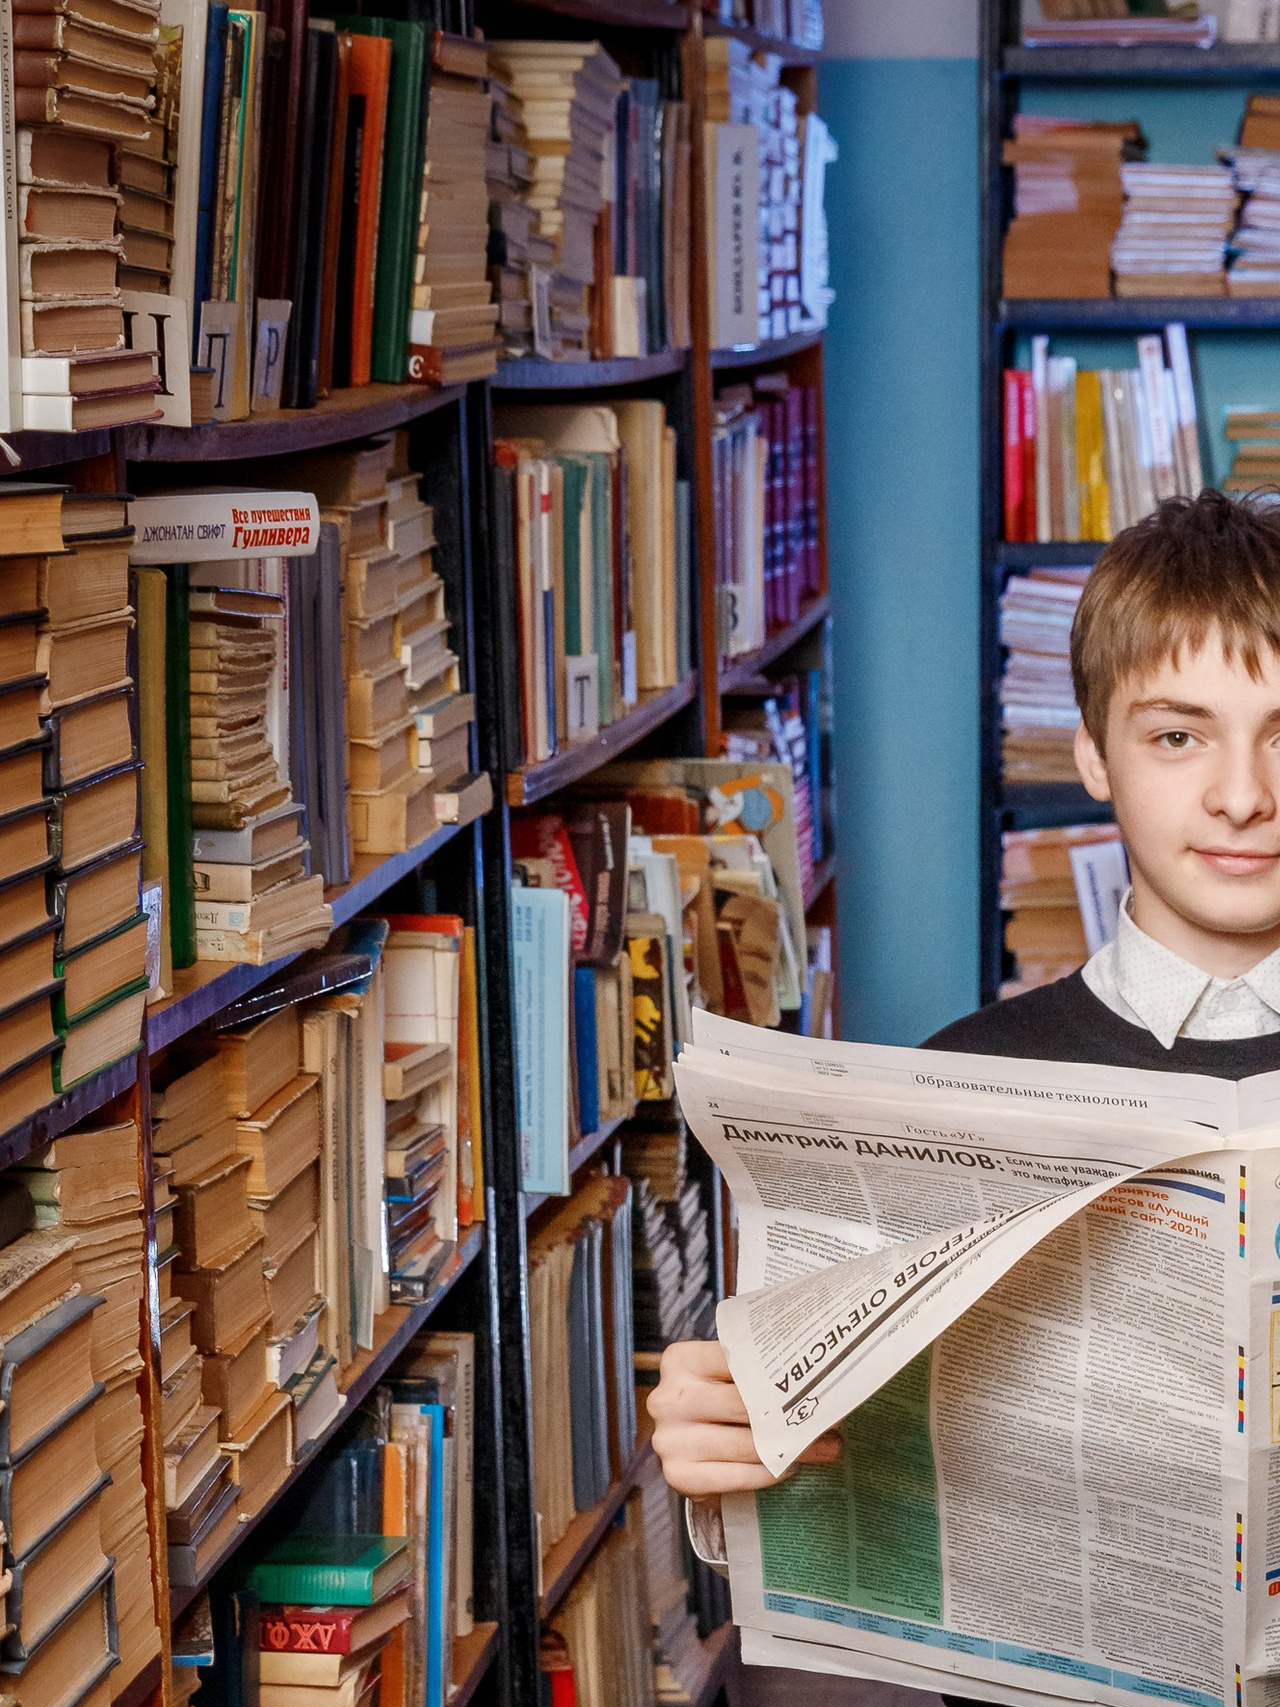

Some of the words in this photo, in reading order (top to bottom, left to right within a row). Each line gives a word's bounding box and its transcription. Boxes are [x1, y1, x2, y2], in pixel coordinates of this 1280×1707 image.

[231, 508, 249, 525] Все
[251, 507, 311, 525] путешествия
[142, 524, 194, 544] ДЖОНАТАН
[197, 523, 226, 540] СВИФТ
[231, 525, 310, 550] Гулливера
[914, 1073, 1054, 1101] Образовательные
[1055, 1091, 1149, 1109] технологии
[905, 1124, 949, 1139] Гость
[722, 1123, 849, 1152] Дмитрий
[856, 1138, 1005, 1172] ДАНИЛОВ:
[1004, 1155, 1033, 1168] Если
[1035, 1162, 1050, 1171] ты
[1054, 1164, 1069, 1173] не
[1011, 1168, 1030, 1180] это
[1129, 1206, 1208, 1241] сайт-2021»
[1147, 1201, 1210, 1228] «Лучший
[893, 1226, 976, 1289] ГЕРОЕВ
[775, 1287, 888, 1394] ОТЕЧЕСТВА
